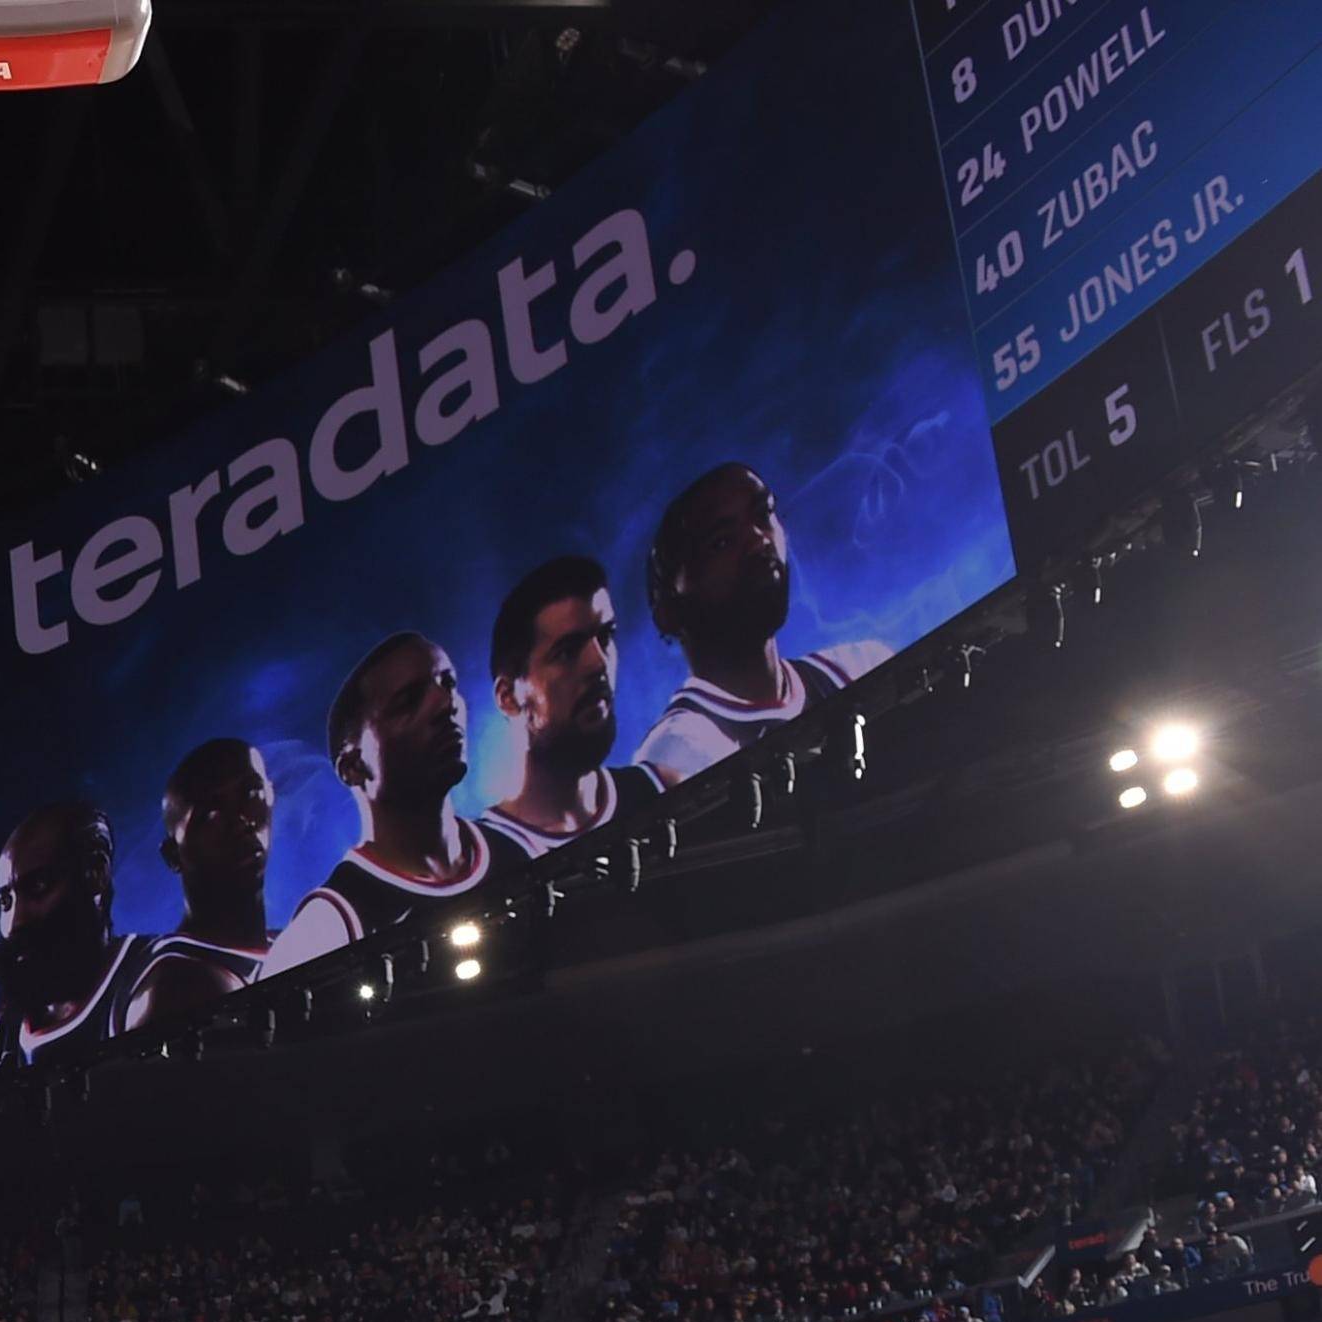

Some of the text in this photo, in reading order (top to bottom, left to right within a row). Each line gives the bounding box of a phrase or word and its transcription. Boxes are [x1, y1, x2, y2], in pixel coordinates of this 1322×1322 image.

[951, 56, 977, 104] 8
[956, 142, 1006, 207] 24
[1020, 6, 1167, 155] POWELL
[975, 119, 1158, 296] 40 ZUBAC
[992, 174, 1244, 392] 55 JONES JR.
[1201, 247, 1313, 373] FLS 1
[1019, 384, 1137, 500] TOL 5
[1245, 1276, 1278, 1296] The
